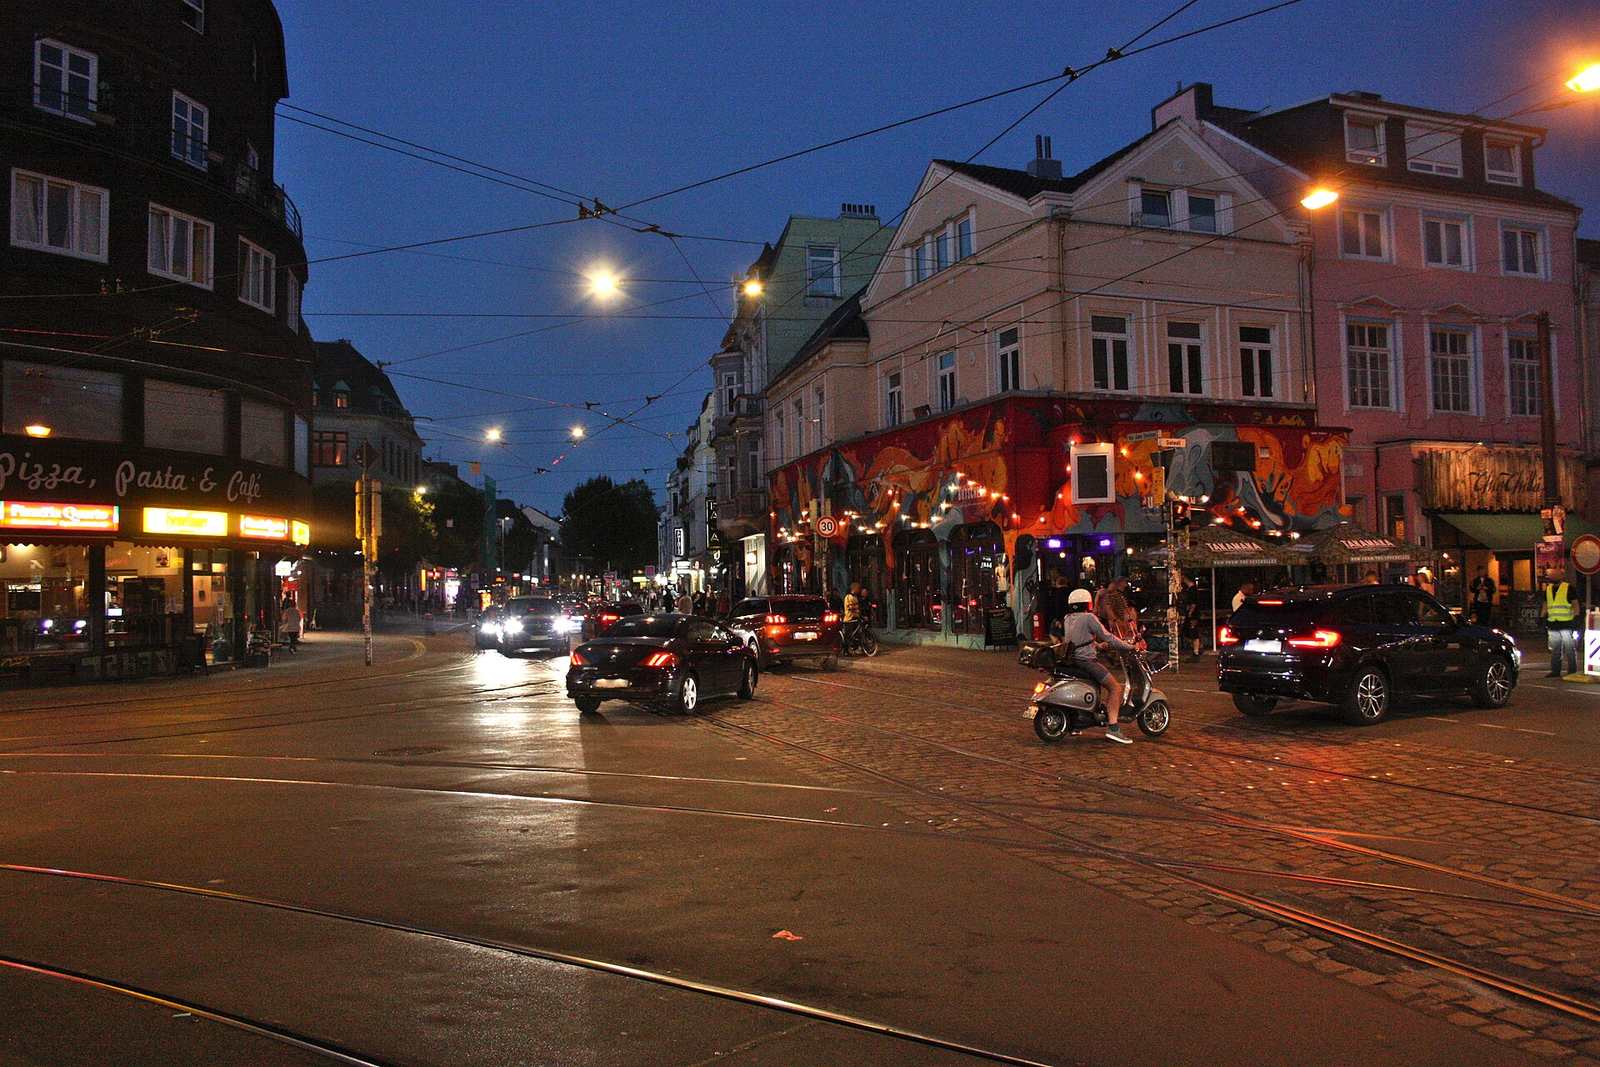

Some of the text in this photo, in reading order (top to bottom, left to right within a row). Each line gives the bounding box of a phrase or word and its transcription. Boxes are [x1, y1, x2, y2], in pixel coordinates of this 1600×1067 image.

[115, 460, 188, 496] Pasta
[199, 466, 217, 492] &
[227, 470, 262, 503] Café
[821, 521, 833, 531] 30
[1205, 542, 1264, 552] TAKAMAKA
[1340, 539, 1396, 549] TAKAMAKA
